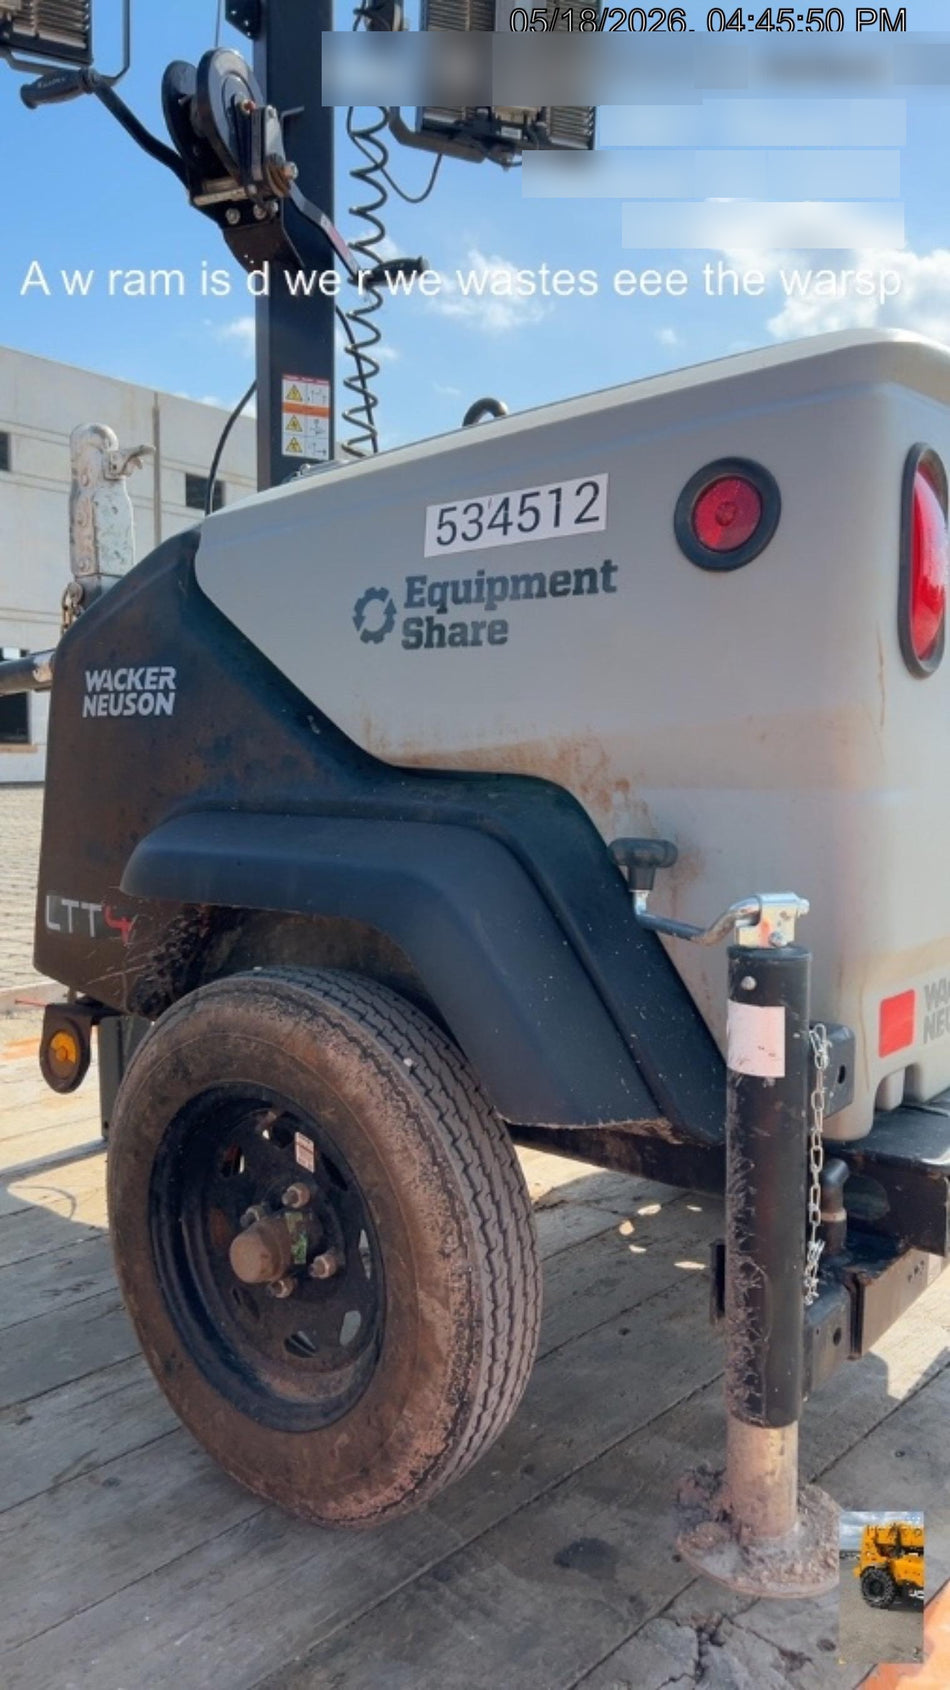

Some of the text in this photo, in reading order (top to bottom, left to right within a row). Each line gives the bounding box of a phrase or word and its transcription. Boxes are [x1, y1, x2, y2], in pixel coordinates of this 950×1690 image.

[436, 480, 600, 546] 534512
[403, 559, 618, 614] Equipment
[401, 615, 509, 650] Share
[85, 666, 177, 692] WACKER
[82, 692, 176, 718] NEUSON
[924, 978, 950, 1012] WA
